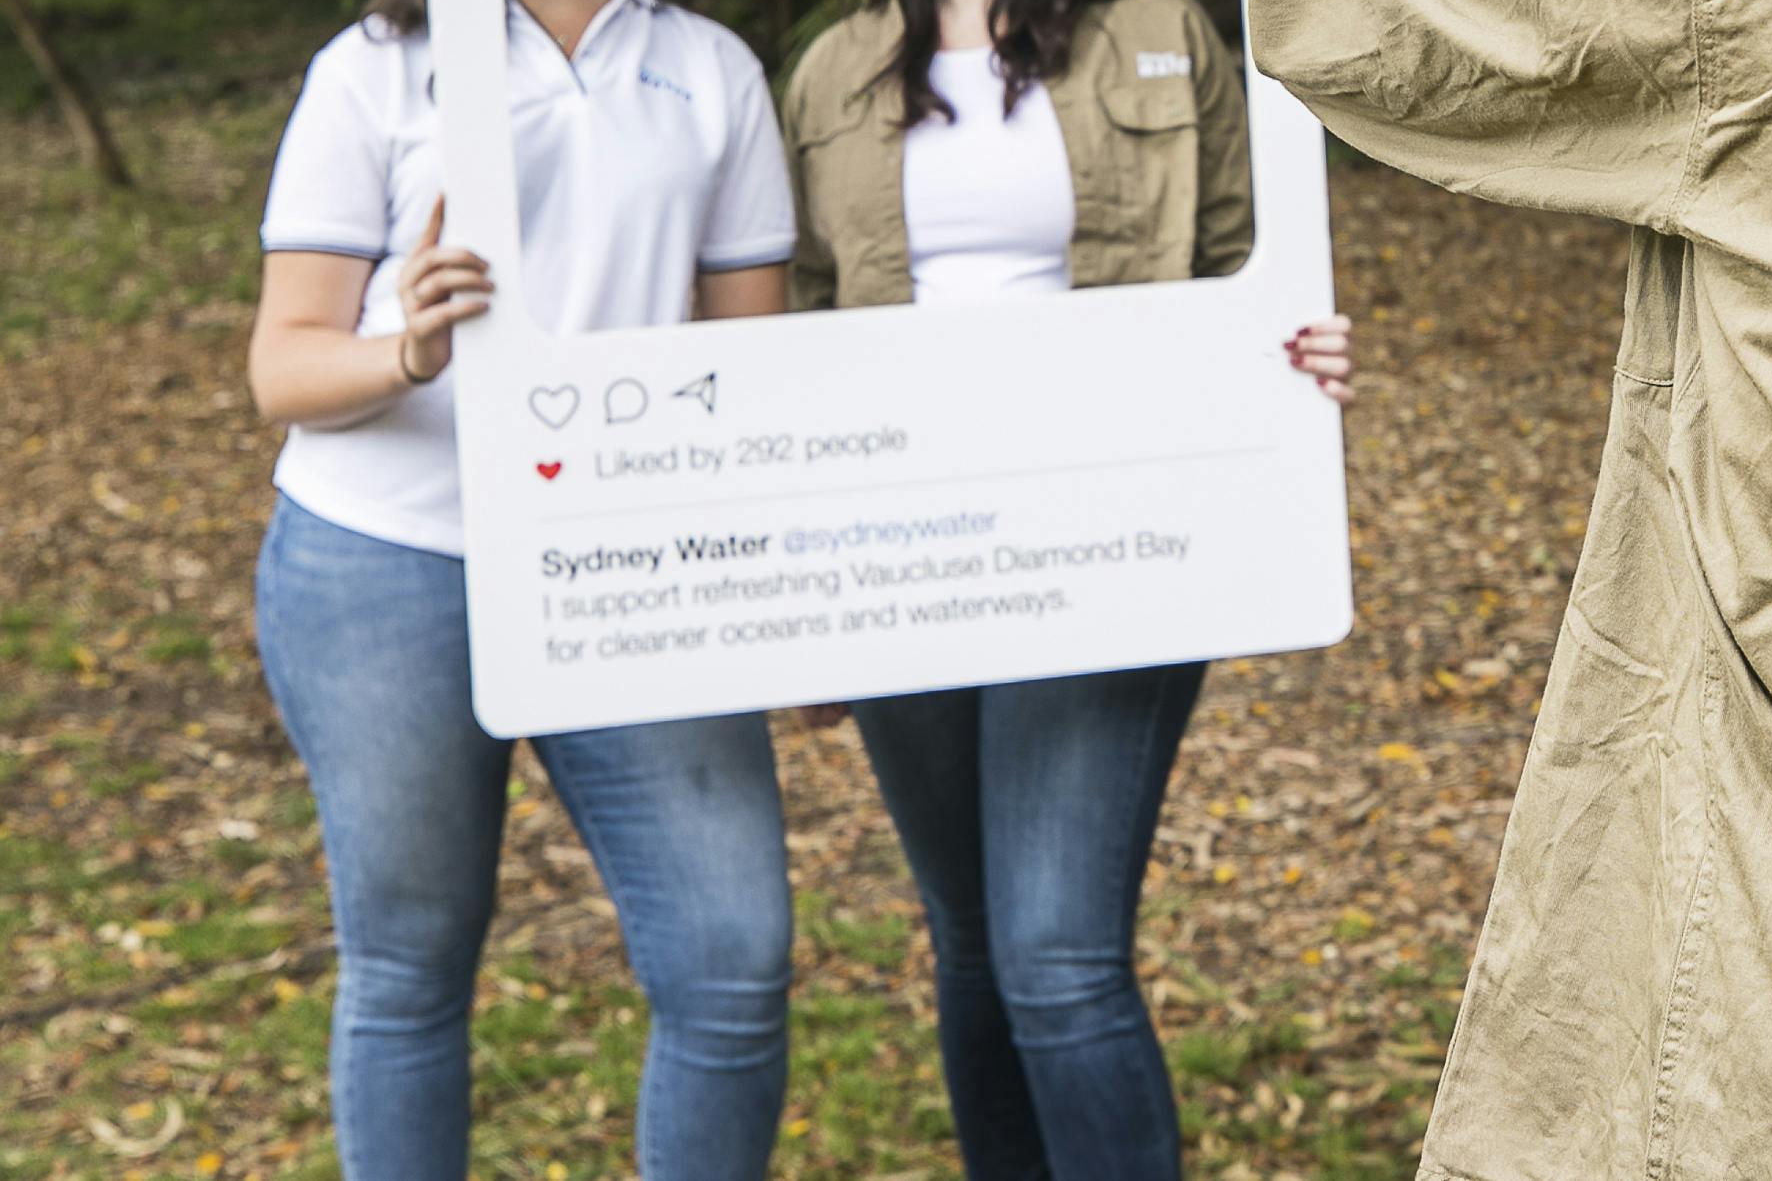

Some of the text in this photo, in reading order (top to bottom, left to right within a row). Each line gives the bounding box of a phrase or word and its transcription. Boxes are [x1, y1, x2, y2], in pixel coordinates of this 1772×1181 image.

[594, 424, 909, 479] Liked by 292 people
[541, 511, 998, 582] Sydney Water @sydneywater
[542, 530, 1191, 621] I support refreshing Vaucluse Diamond Bay
[545, 587, 1073, 665] for cleaner oceans and waterways.
